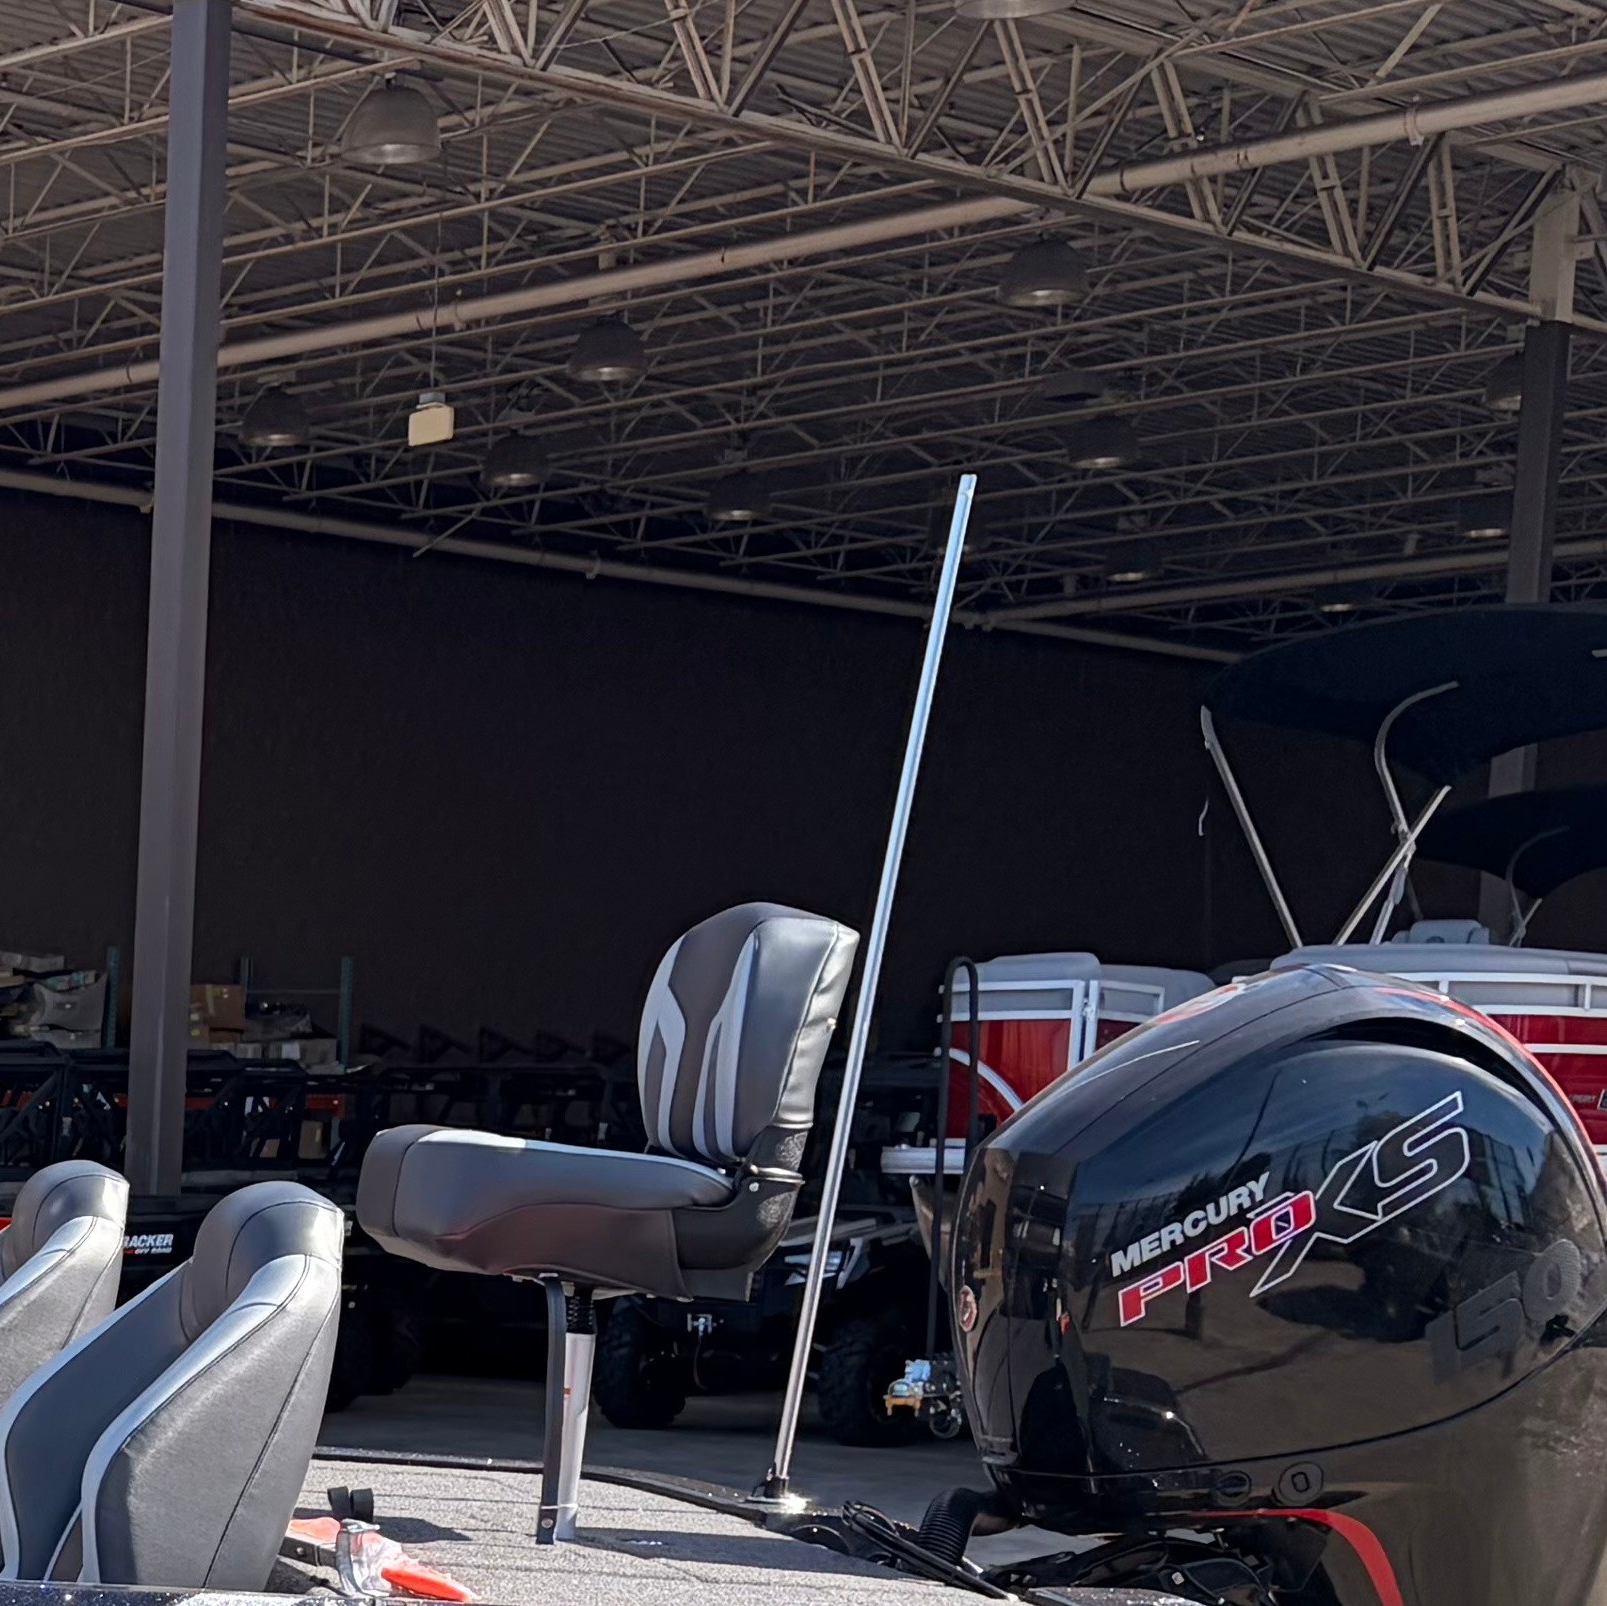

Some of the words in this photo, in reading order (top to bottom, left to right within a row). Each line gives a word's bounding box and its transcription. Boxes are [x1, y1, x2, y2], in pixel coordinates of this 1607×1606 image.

[123, 1233, 174, 1248] RACKER
[1111, 1171, 1270, 1278] MERCURY
[1119, 1190, 1317, 1328] PRO
[1250, 1090, 1470, 1299] XS
